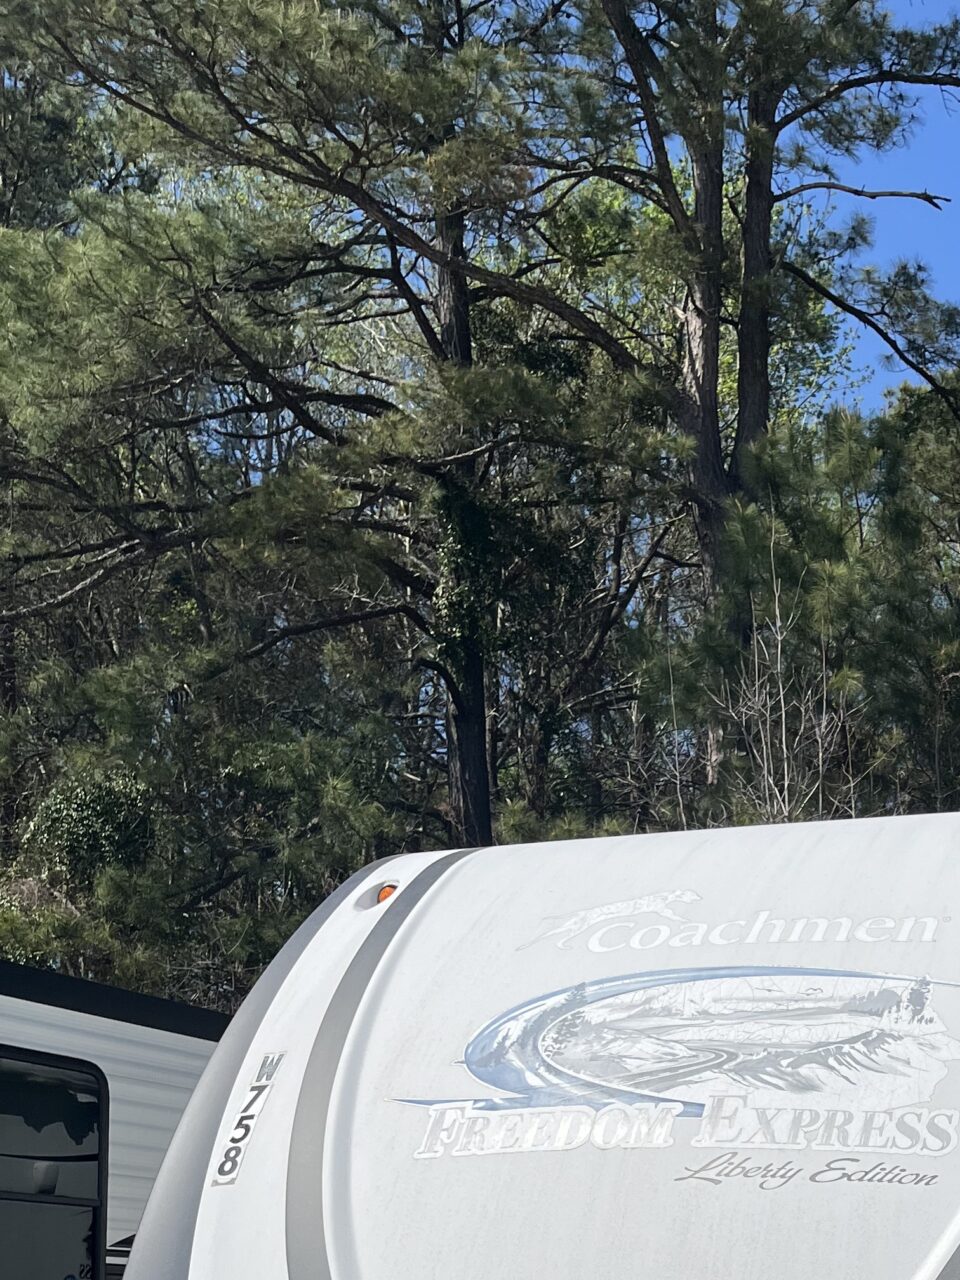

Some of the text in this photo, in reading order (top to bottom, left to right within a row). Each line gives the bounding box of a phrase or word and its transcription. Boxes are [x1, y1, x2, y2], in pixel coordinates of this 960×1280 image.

[586, 909, 938, 954] Coachmen
[416, 1094, 955, 1156] FREEDOM EXPRESS
[674, 1151, 940, 1191] Liberty Edition
